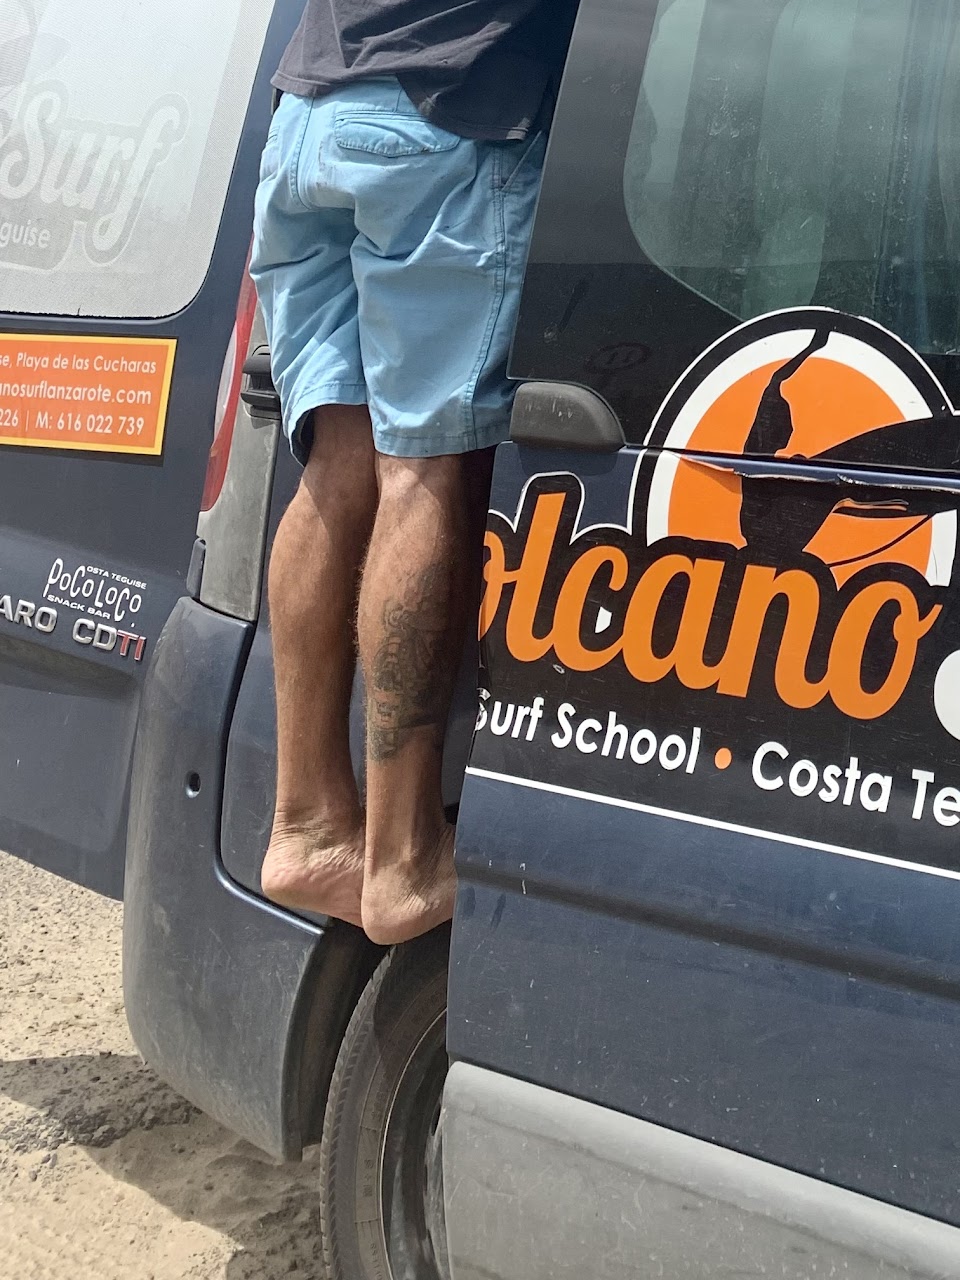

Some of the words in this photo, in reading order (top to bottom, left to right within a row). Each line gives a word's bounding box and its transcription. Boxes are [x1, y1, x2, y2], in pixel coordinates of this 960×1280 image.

[0, 90, 181, 251] Surf
[16, 351, 50, 372] Playa
[52, 353, 69, 369] de
[72, 354, 90, 371] las
[93, 355, 157, 374] Cucharas
[0, 380, 152, 405] nosurflanzarote.com
[35, 411, 53, 430] M:
[57, 412, 82, 432] 616
[86, 414, 113, 434] 022
[118, 415, 145, 436] 739
[111, 573, 148, 590] TEGUISE
[47, 594, 86, 612] SNACK
[87, 607, 111, 620] BAR
[477, 491, 943, 720] lcano
[0, 594, 58, 633] ARO
[72, 618, 147, 661] CDTI
[551, 702, 702, 775] School
[751, 741, 893, 813] Costa
